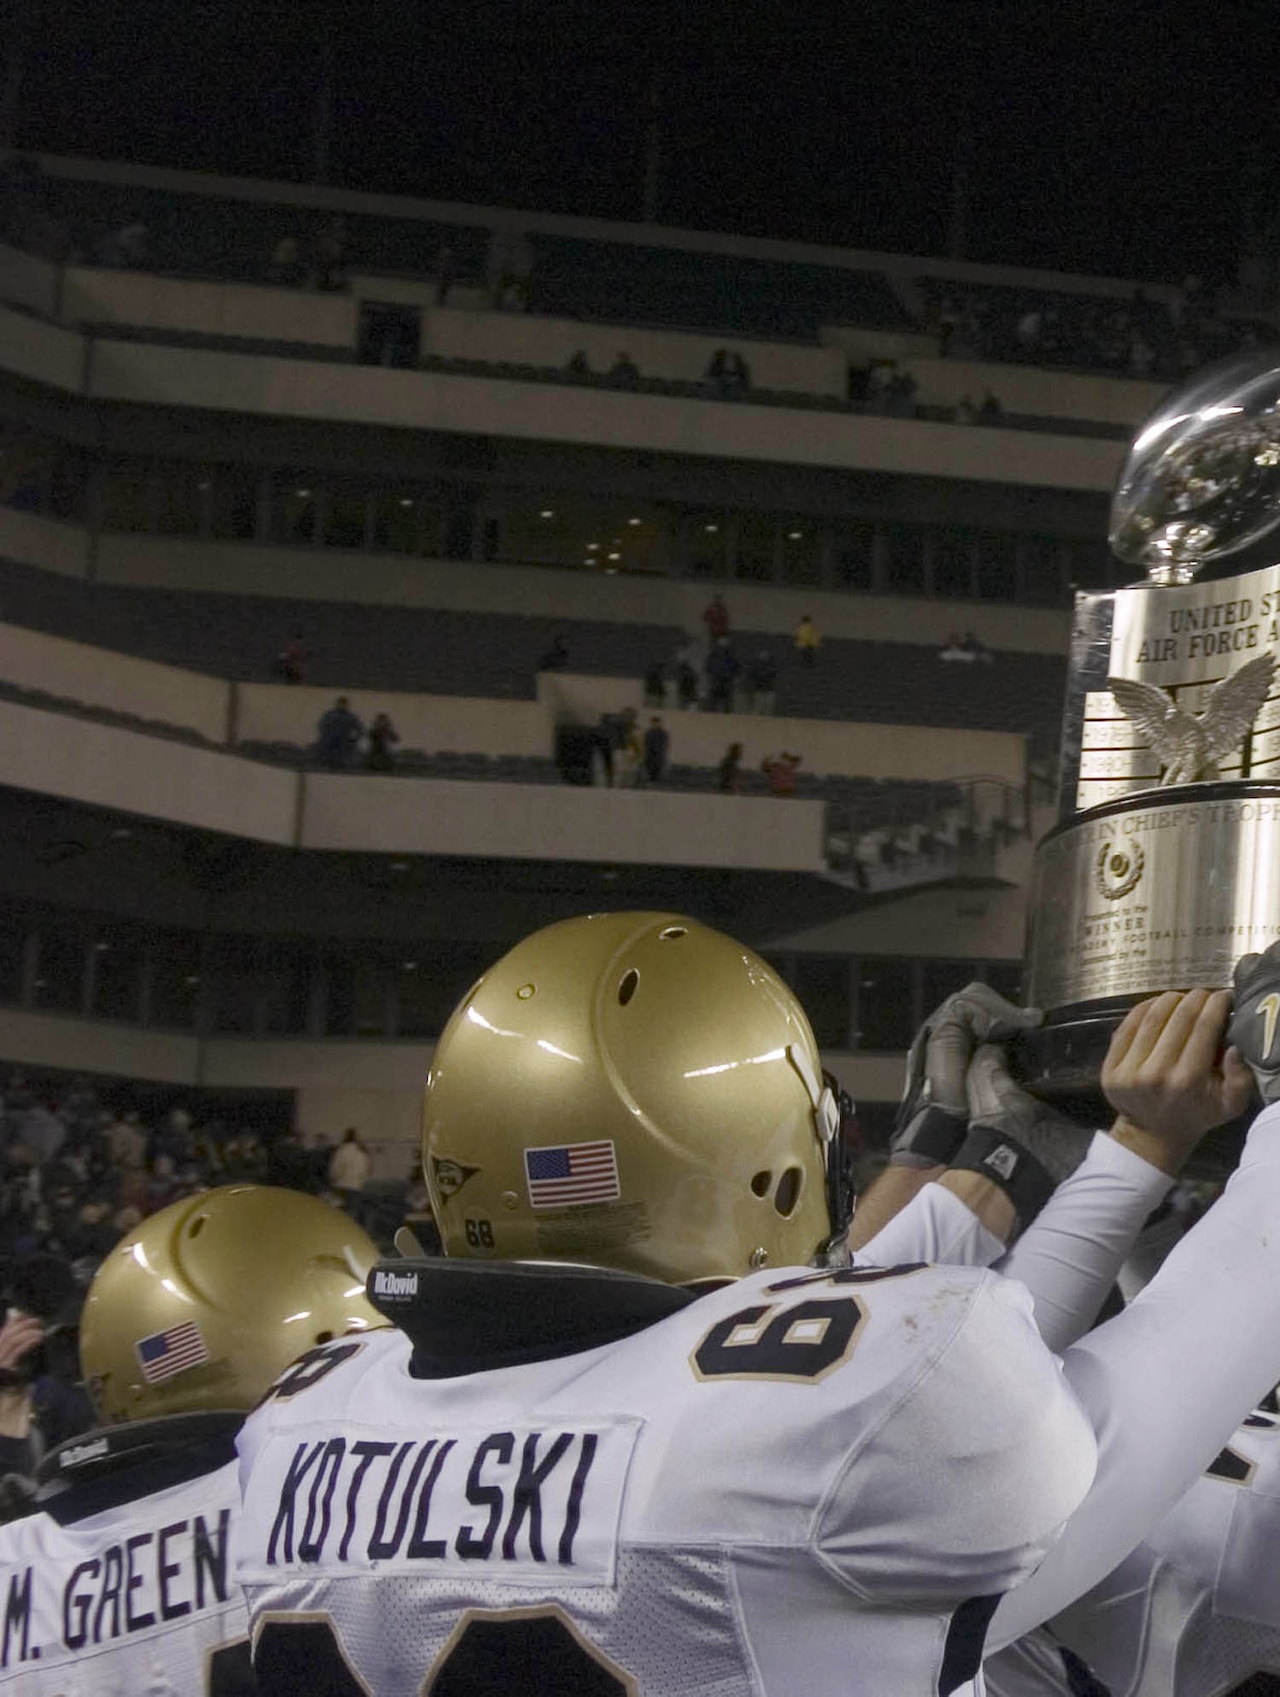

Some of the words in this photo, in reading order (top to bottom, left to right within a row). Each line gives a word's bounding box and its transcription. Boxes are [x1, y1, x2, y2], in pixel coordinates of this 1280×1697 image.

[1168, 599, 1254, 634] UNITED
[1136, 638, 1179, 663] AIR
[1187, 624, 1259, 659] FORCE
[374, 1271, 418, 1295] McDavid
[266, 1431, 599, 1565] KOTULSKI
[0, 1566, 42, 1667] M.
[63, 1508, 231, 1650] GREEN
